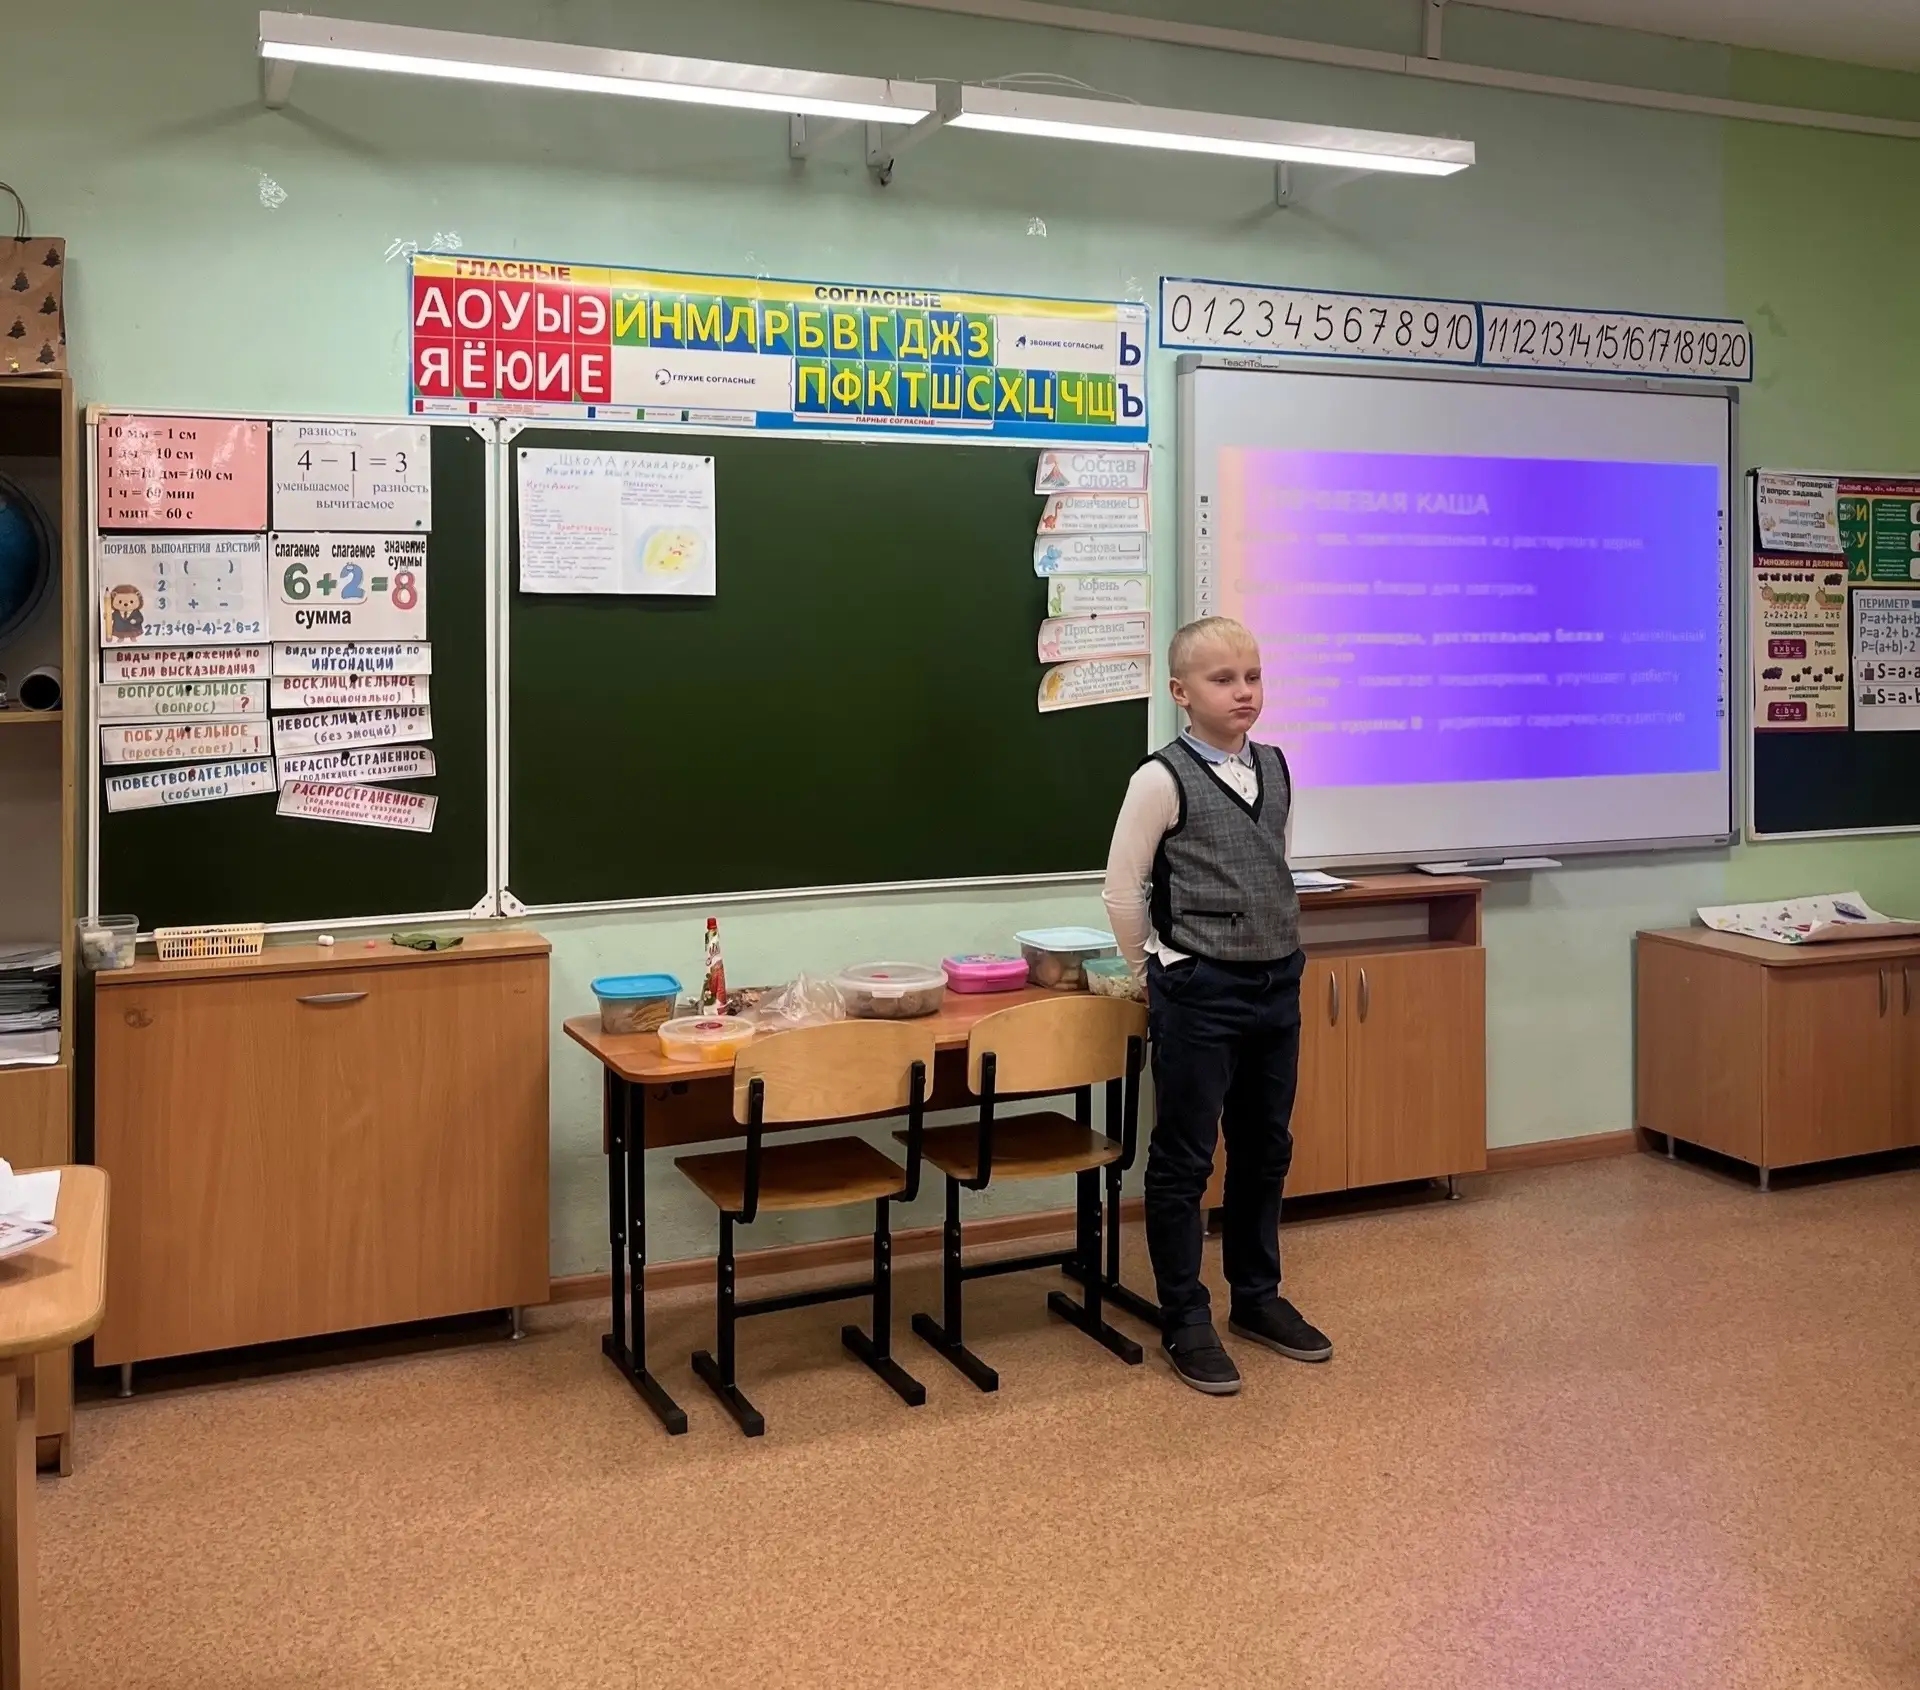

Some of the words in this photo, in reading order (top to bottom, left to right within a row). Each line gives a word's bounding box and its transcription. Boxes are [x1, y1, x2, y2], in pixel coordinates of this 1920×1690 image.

[456, 259, 571, 281] ГЛАСНЫЕ
[815, 286, 941, 308] СОГЛАСНЫЕ
[416, 287, 452, 328] А
[457, 289, 493, 329] О
[498, 291, 531, 331] У
[537, 293, 570, 333] Ы
[578, 296, 606, 335] Э
[615, 292, 646, 339] Й
[653, 301, 682, 340] Н
[687, 303, 720, 342] М
[724, 306, 756, 344] Л
[765, 310, 789, 346] Р
[799, 311, 824, 348] Б
[833, 313, 859, 350] В
[870, 315, 888, 352] Г
[899, 318, 928, 359] Д
[931, 319, 961, 356] Ж
[968, 321, 988, 358] З
[1171, 294, 1192, 332] 0
[1204, 297, 1216, 334] 1
[1223, 298, 1245, 336] 2
[1256, 300, 1274, 337] 3
[1284, 302, 1302, 340] 4
[1314, 304, 1334, 341] 5
[1343, 306, 1362, 343] 6
[1370, 308, 1387, 345] 7
[1395, 310, 1413, 346] 8
[1421, 312, 1439, 348] 9
[1446, 314, 1472, 350] 10
[1029, 339, 1061, 348] ЗВОНКИЕ
[1063, 341, 1104, 350] СОГЛАСНЫЕ
[1488, 317, 1508, 353] 11
[1512, 319, 1536, 354] 12
[1541, 321, 1564, 356] 13
[1569, 322, 1590, 357] 14
[1596, 325, 1618, 359] 15
[1622, 326, 1645, 361] 16
[1649, 328, 1670, 362] 17
[1673, 330, 1694, 364] 18
[1698, 332, 1718, 366] 19
[1719, 333, 1746, 368] 20
[419, 347, 449, 387] Я
[463, 341, 486, 389] Ё
[496, 350, 533, 391] Ю
[538, 352, 570, 392] И
[580, 354, 603, 393] Е
[673, 374, 704, 383] ГЛУХИЕ
[706, 375, 756, 385] СОГЛАСНЫЕ
[799, 366, 825, 404] П
[832, 368, 862, 406] Ф
[867, 369, 892, 407] К
[902, 372, 926, 408] Т
[932, 373, 960, 410] Ш
[967, 375, 990, 411] С
[998, 377, 1022, 413] Х
[1028, 378, 1054, 420] Ц
[1061, 380, 1082, 416] Ч
[1089, 382, 1115, 421] Щ
[855, 416, 887, 424] ПАРНЫЕ
[889, 418, 935, 426] СОГЛАСНЫЕ
[108, 427, 122, 438] 10
[168, 429, 173, 439] 1
[179, 431, 196, 440] см
[299, 426, 357, 438] разность
[108, 447, 113, 457] 1
[157, 448, 171, 459] 10
[177, 450, 193, 459] см
[298, 450, 312, 471] 4
[350, 451, 357, 472] 1
[396, 452, 407, 473] 3
[1072, 455, 1136, 473] Состав
[108, 467, 113, 477] 1
[216, 471, 233, 481] см
[1079, 474, 1128, 488] слова
[108, 487, 113, 498] 1
[119, 490, 127, 498] ч
[166, 490, 195, 499] мин
[277, 481, 349, 493] уменьшаемое
[373, 483, 428, 494] разность
[1767, 488, 1790, 496] вопрос
[316, 500, 394, 509] вычитаемое
[1065, 497, 1127, 509] Окончание
[1416, 493, 1489, 515] КАША
[108, 507, 113, 518] 1
[119, 510, 148, 519] мин
[167, 508, 181, 519] 60
[187, 511, 193, 519] с
[1856, 504, 1867, 521] И
[1857, 532, 1867, 548] У
[104, 544, 146, 554] ПОРЯДОК
[152, 543, 210, 553] ВЫПОЛНЕНИЯ
[216, 542, 260, 553] ДЕЙСТВИЙ
[275, 543, 319, 558] слагаемое
[332, 544, 375, 558] слагаемое
[385, 540, 425, 553] значение
[1074, 542, 1116, 553] Основа
[159, 562, 164, 574] 1
[388, 556, 422, 570] суммы
[1758, 557, 1805, 568] Умножение
[1812, 559, 1844, 568] деление
[1856, 559, 1867, 576] А
[158, 580, 166, 592] 2
[1078, 579, 1120, 593] Корень
[159, 598, 166, 609] 3
[1860, 599, 1909, 608] ПЕРИМЕТР
[296, 610, 351, 629] сумма
[1065, 623, 1125, 638] Приставка
[117, 652, 149, 663] Виды
[155, 649, 241, 663] предложений
[246, 650, 260, 658] по
[285, 647, 316, 657] Виды
[321, 645, 402, 657] предложений
[122, 667, 155, 679] ЦЕЛИ
[161, 664, 255, 677] ВЫСКАЗЫВАНИЯ
[312, 657, 394, 672] ИНТОНАЦИИ
[1073, 662, 1127, 677] Суффикс
[283, 676, 416, 689] ВОСКЛИЦАТЕЛЬНОЕ
[118, 684, 247, 698] ВОПРОСИТЕЛЬНОЕ
[303, 692, 401, 706] (эмоционально)
[277, 707, 425, 731] НЕВОСКЛИЦАТЕЛЬНОЕ
[124, 725, 248, 743] ПОБУДИТЕЛЬНОЕ
[314, 730, 342, 745] (без
[347, 724, 397, 739] эмоций)
[284, 750, 426, 773] НЕРАСПРОСТРАНЕННОЕ
[112, 761, 268, 792] ПОВЕСТВОВАТЕЛЬНОЕ
[162, 783, 228, 803] (событие)
[292, 783, 426, 808] РАСПРОСТРАНЕННОЕ
